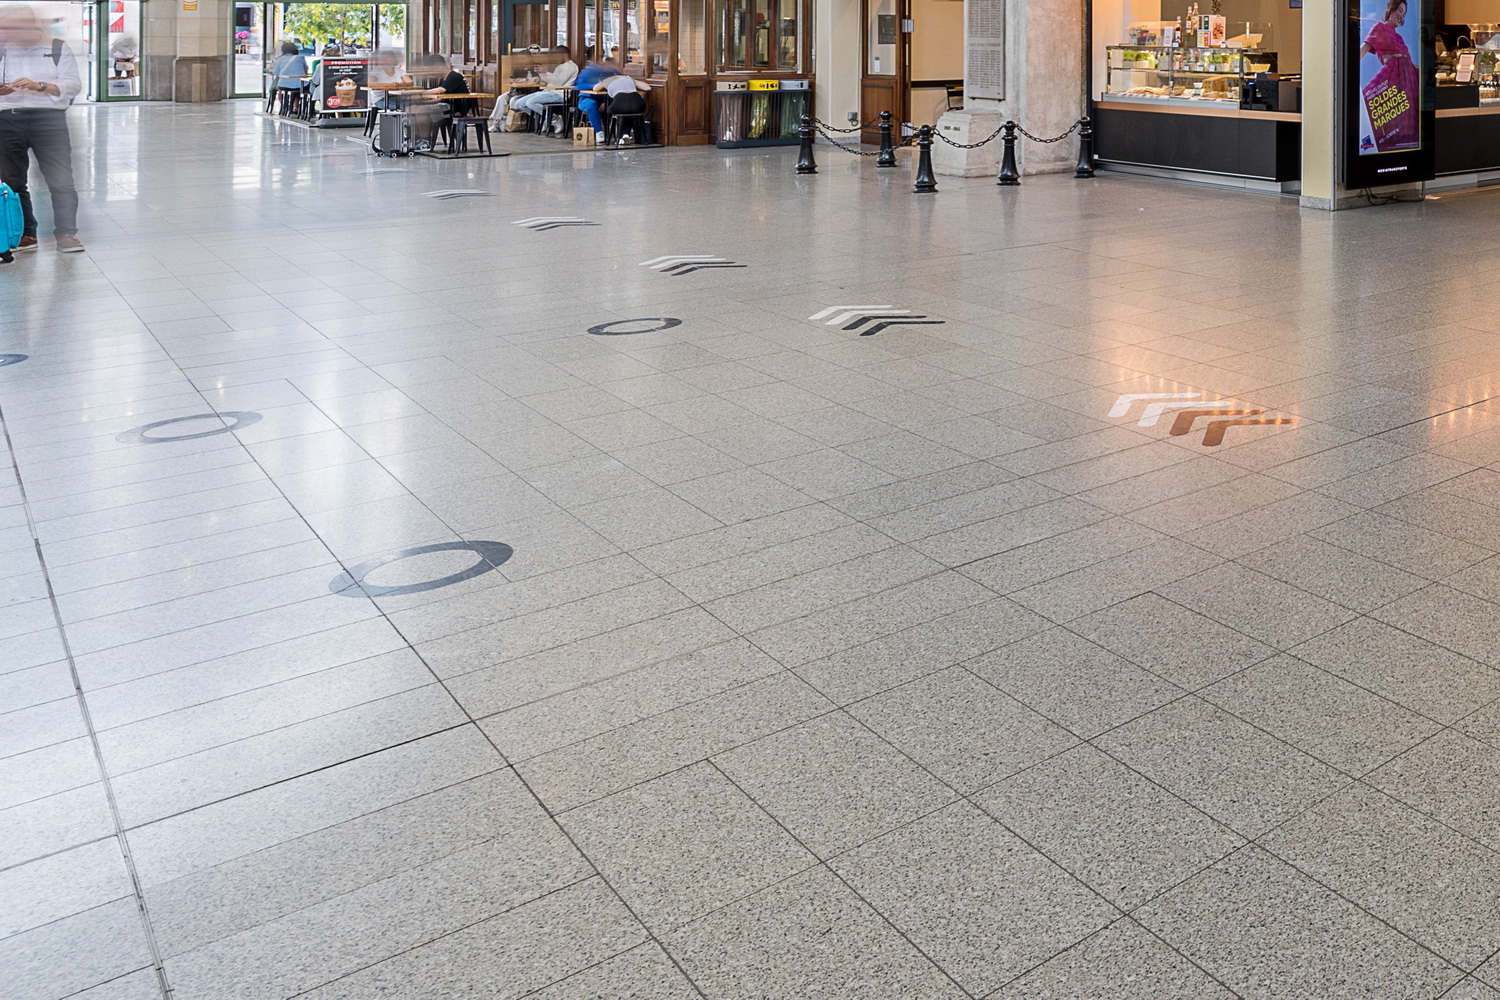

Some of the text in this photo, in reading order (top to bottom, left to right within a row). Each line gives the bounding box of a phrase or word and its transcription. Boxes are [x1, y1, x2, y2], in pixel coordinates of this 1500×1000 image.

[1368, 85, 1398, 110] SOLDES
[1371, 90, 1407, 120] GRANDES
[1373, 100, 1410, 130] MARQUES
